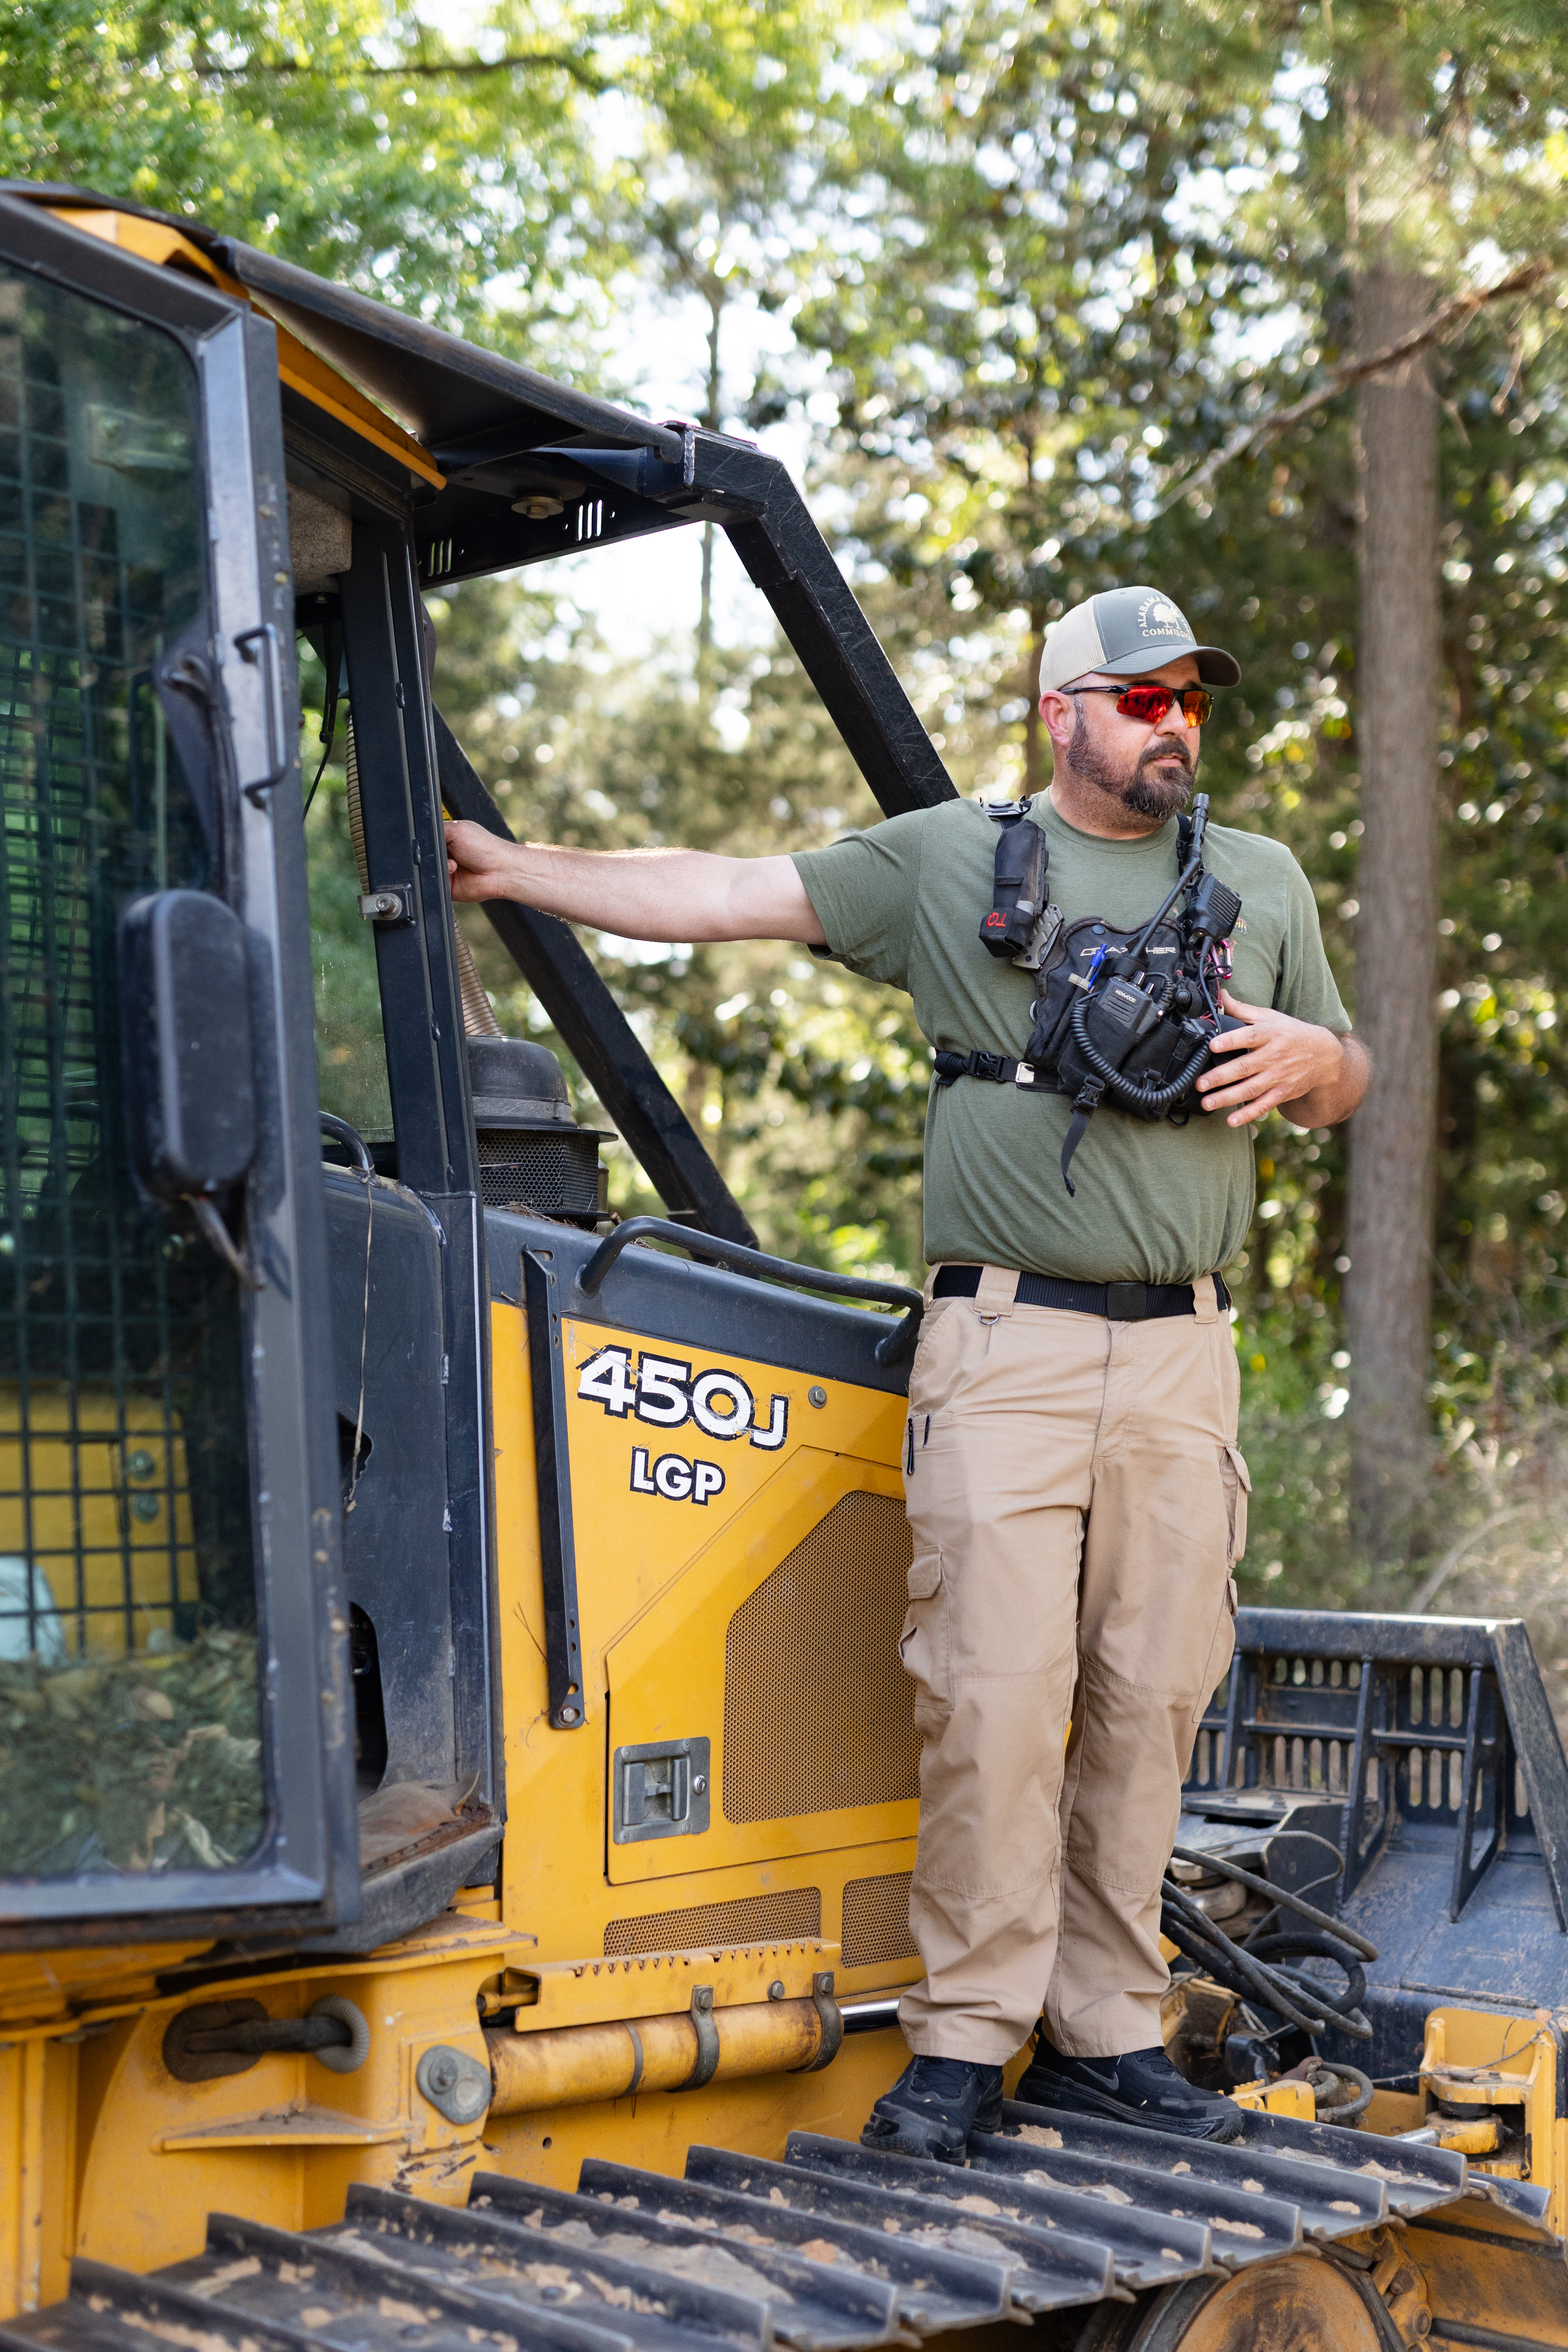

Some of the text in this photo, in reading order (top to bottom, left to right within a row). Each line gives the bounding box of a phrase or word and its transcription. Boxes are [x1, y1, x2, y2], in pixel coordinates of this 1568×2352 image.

[1138, 595, 1161, 628] ALABAMA
[1142, 628, 1193, 642] COMMISSION
[986, 912, 1007, 928] TQ
[1080, 946, 1176, 956] CAHER
[1115, 989, 1136, 1003] KENWOOD
[576, 1344, 789, 1451] 450J
[630, 1446, 726, 1506] LGP
